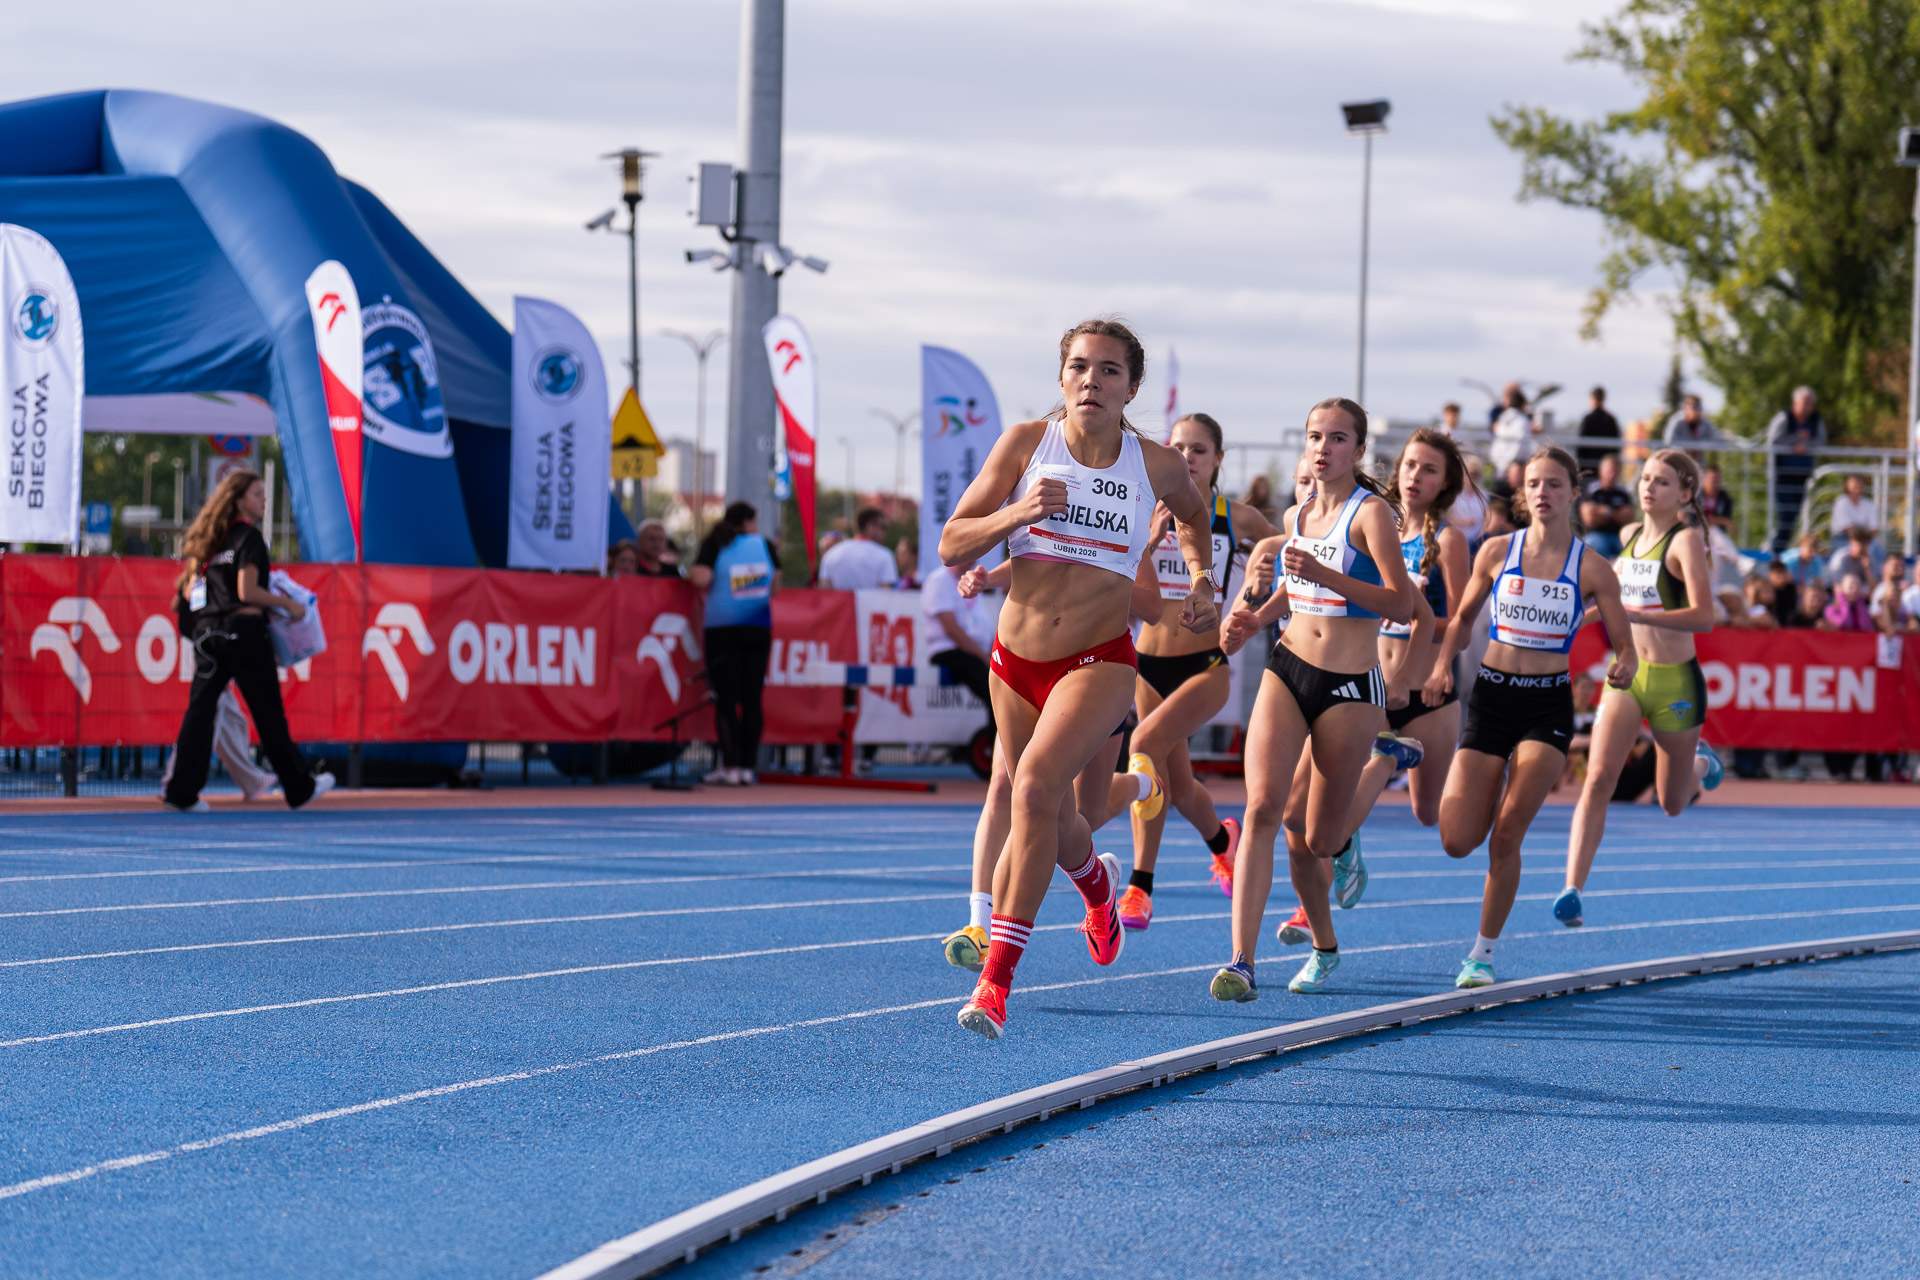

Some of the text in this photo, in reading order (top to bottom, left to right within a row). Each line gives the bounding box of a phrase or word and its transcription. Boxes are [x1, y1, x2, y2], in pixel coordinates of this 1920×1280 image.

[9, 384, 28, 498] SEKCJA
[28, 372, 50, 510] BIEGOWA
[533, 431, 554, 531] SEKCJA
[554, 421, 574, 541] BIEGOWA
[1092, 478, 1128, 500] 308
[1046, 502, 1129, 535] SIELSKA
[1053, 543, 1098, 558] LUBIN 2026
[1313, 544, 1337, 561] 547
[1632, 562, 1653, 575] 934
[1542, 584, 1569, 600] 915
[1499, 602, 1569, 627] PUSTÓWKA
[448, 619, 597, 687] ORLEN
[1079, 655, 1095, 665] LKS
[1509, 676, 1552, 688] NIKE
[1702, 661, 1877, 713] ORLEN
